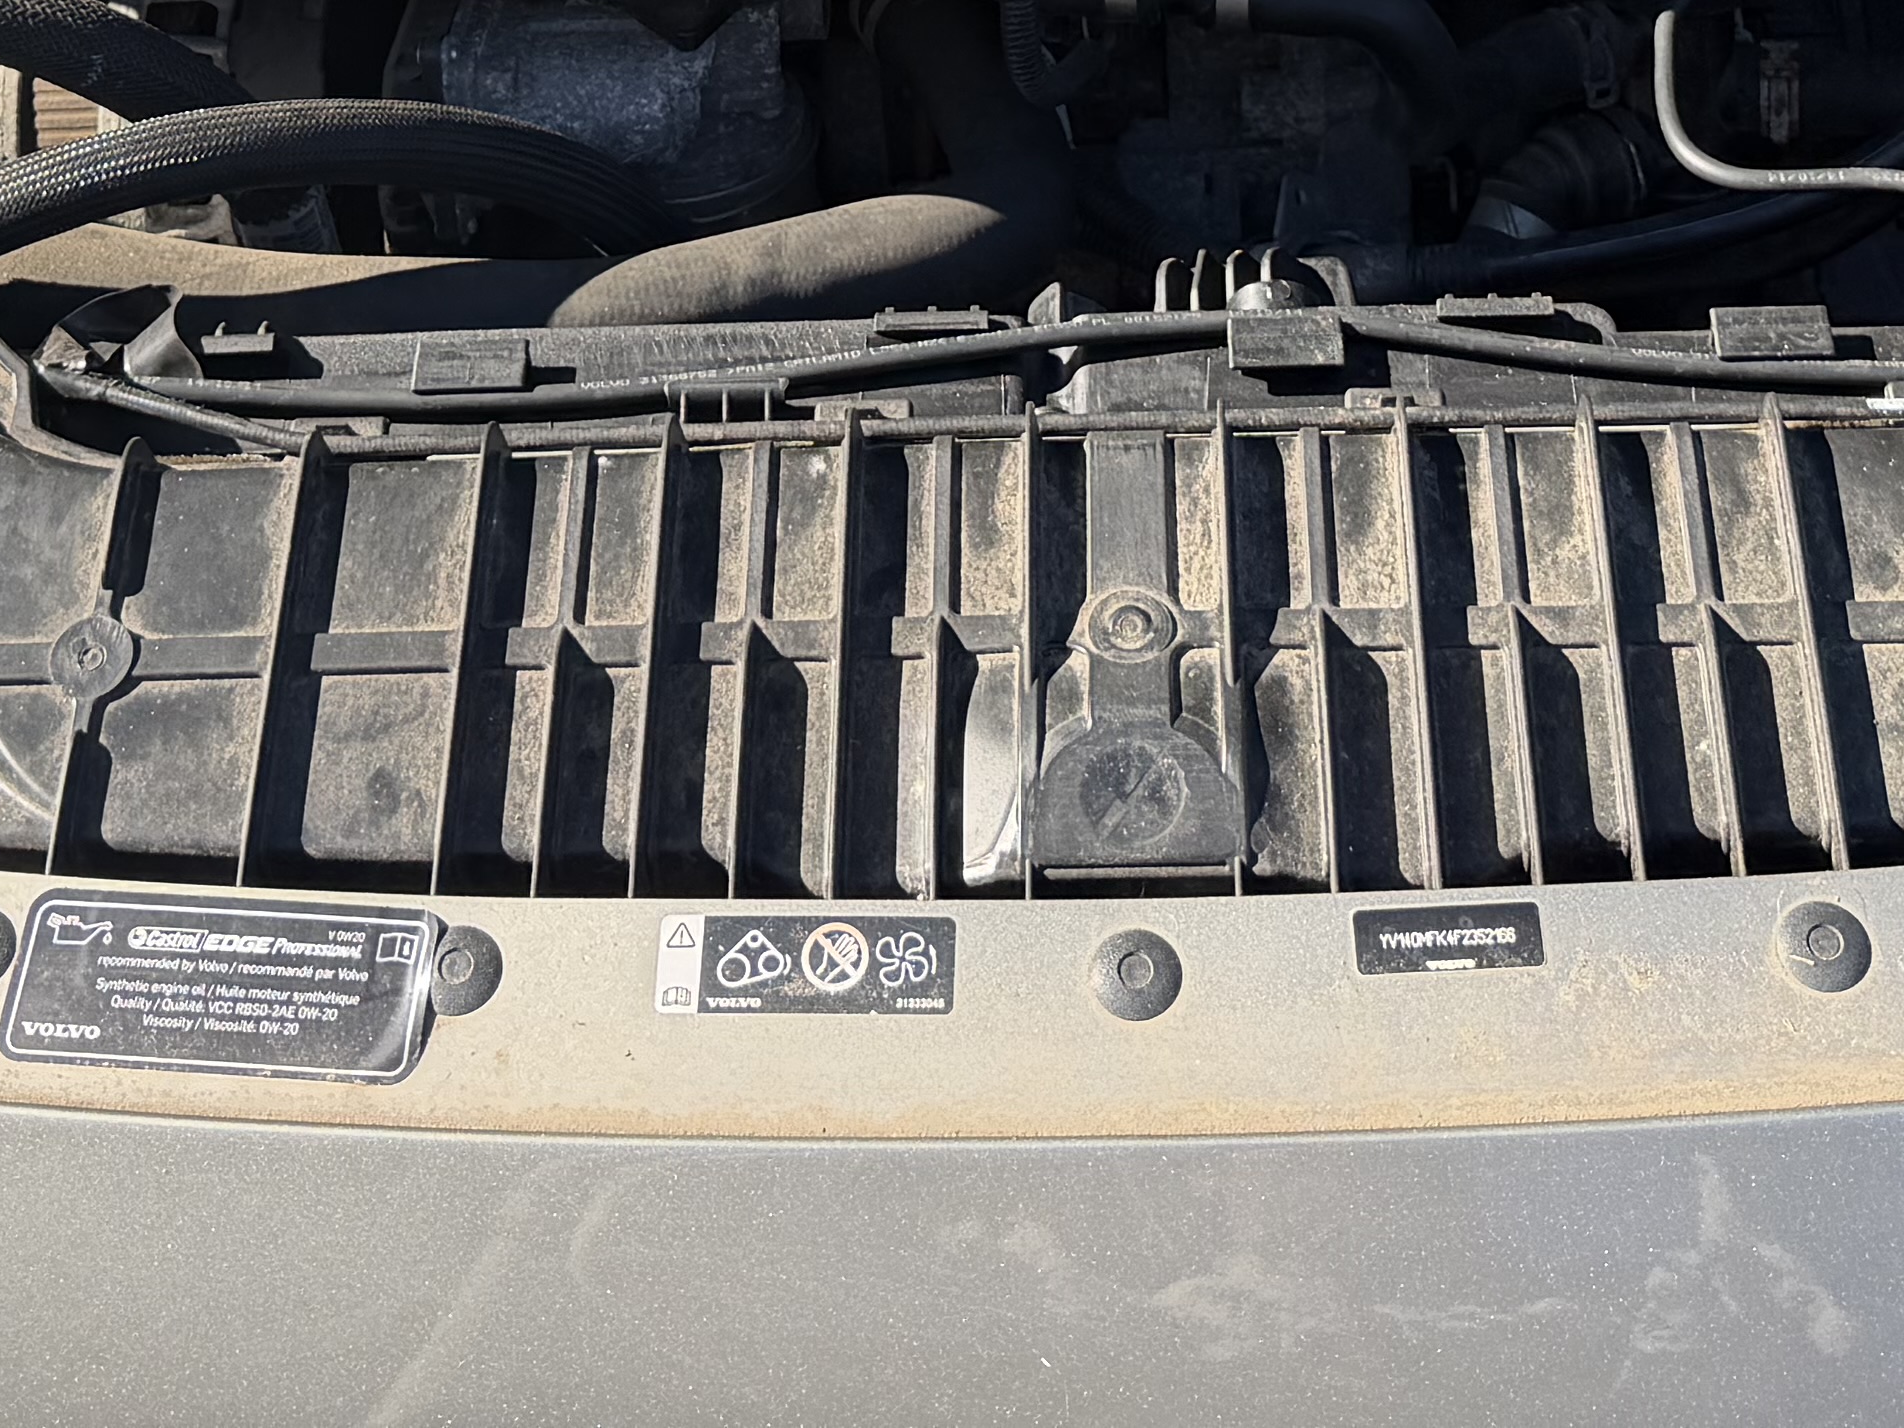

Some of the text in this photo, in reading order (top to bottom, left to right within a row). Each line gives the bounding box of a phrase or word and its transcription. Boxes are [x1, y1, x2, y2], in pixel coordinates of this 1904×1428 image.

[144, 928, 202, 949] Castrol
[201, 932, 275, 954] EDGE
[96, 953, 180, 971] recommended
[179, 958, 196, 972] by
[195, 959, 230, 974] Volvo
[236, 961, 314, 979] recommandé
[313, 966, 336, 980] par
[335, 967, 370, 982] Volvo
[93, 977, 151, 993] Synthetic
[150, 981, 191, 996] engine
[189, 983, 206, 997] oil
[214, 984, 247, 999] Huile
[246, 986, 291, 1002] moteur
[290, 989, 361, 1006] synthétique
[109, 994, 153, 1010] Quality
[206, 1000, 234, 1015] VCC
[705, 997, 762, 1009] VOLVO
[17, 1019, 103, 1041] VOLVO
[140, 1013, 194, 1029] Viscosity
